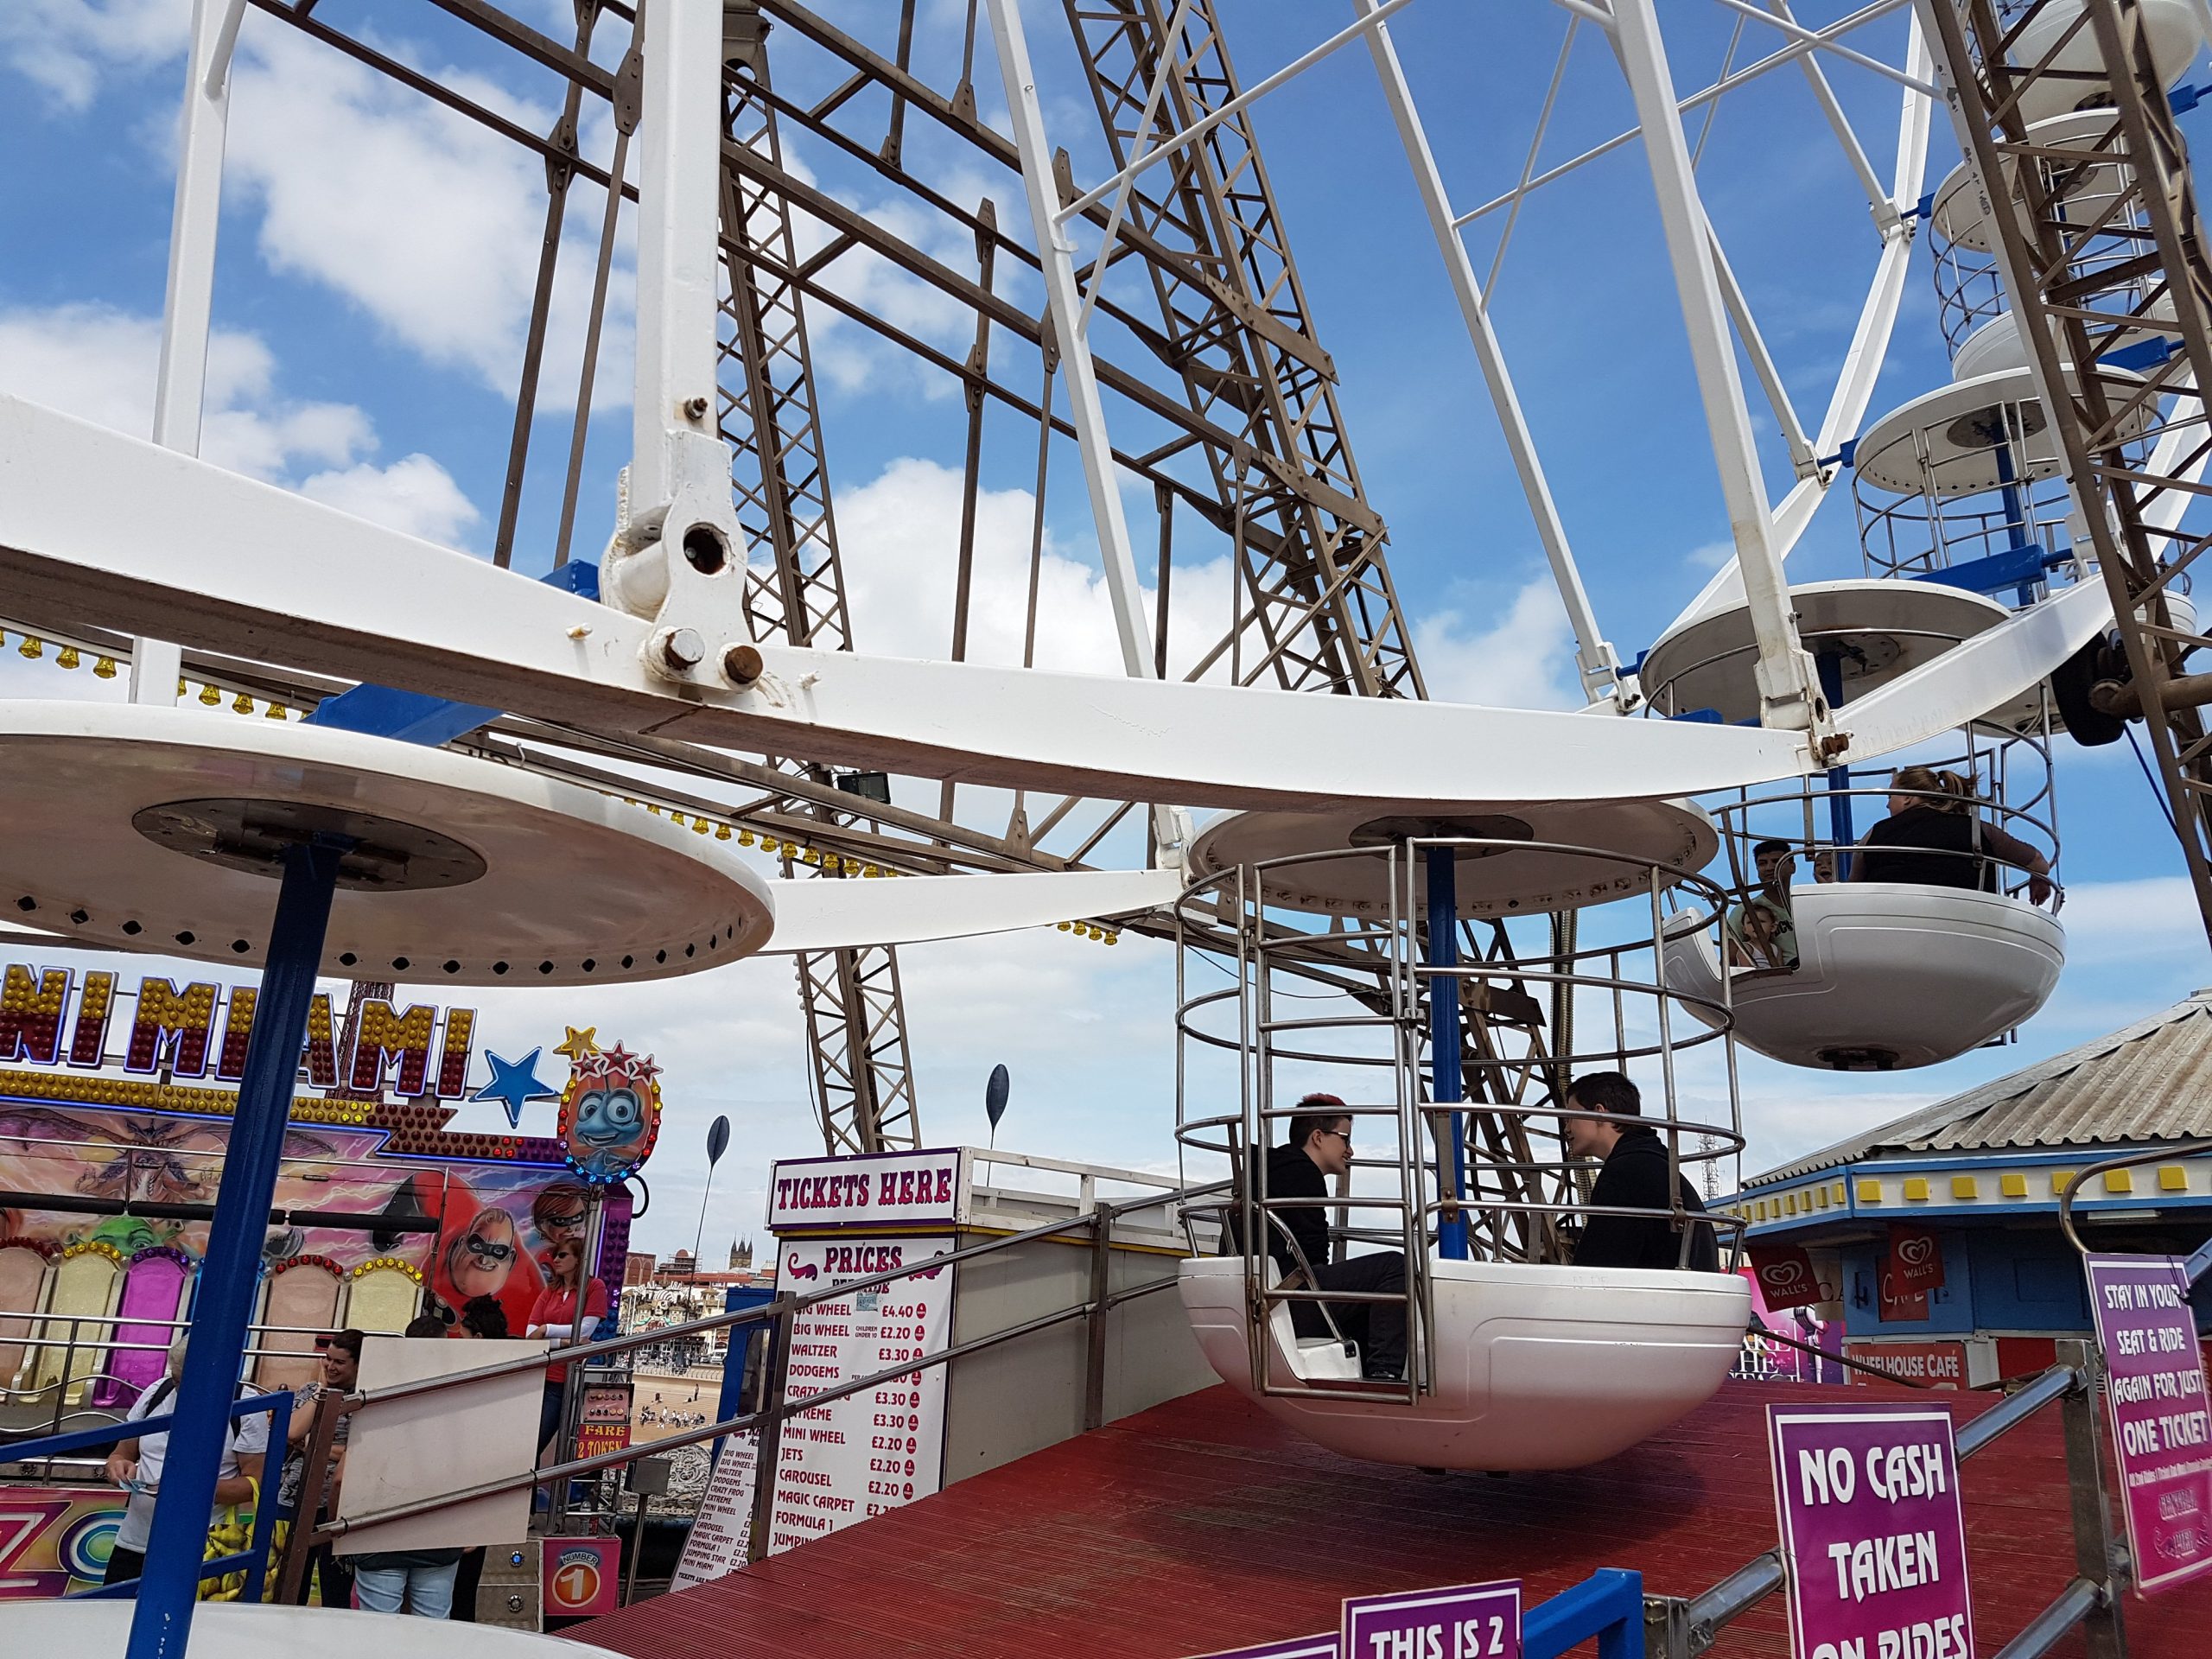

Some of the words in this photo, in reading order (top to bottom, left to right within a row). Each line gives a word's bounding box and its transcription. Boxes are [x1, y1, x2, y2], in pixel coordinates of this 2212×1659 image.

[778, 1174, 870, 1210] TICKETS
[878, 1168, 952, 1206] HERE
[823, 1246, 902, 1274] PRICES
[1904, 1264, 1934, 1280] WALL'S
[1770, 1284, 1808, 1299] WALL'S
[2105, 1285, 2133, 1311] STAY
[2133, 1284, 2149, 1307] IN
[2149, 1284, 2181, 1310] YOUR
[817, 1304, 851, 1317] WHEEL
[882, 1305, 913, 1318] £4.40
[793, 1324, 810, 1336] BIG
[815, 1325, 849, 1337] WHEEL
[880, 1327, 911, 1339] £2.20
[2117, 1330, 2144, 1356] SEAT
[2147, 1330, 2158, 1352] &
[2159, 1327, 2186, 1353] RIDE
[791, 1344, 837, 1358] WALTZER
[879, 1348, 909, 1361] £3.30
[789, 1364, 840, 1378] DODGEMS
[1739, 1351, 1779, 1374] HE
[1927, 1350, 1961, 1377] CAFÉ
[787, 1385, 819, 1398] CRAZY
[875, 1392, 906, 1405] £3.30
[2114, 1375, 2152, 1405] AGAIN
[2153, 1372, 2178, 1399] FOR
[2178, 1370, 2203, 1400] JUST
[791, 1408, 832, 1421] TREME
[874, 1414, 905, 1428] £3.30
[585, 1426, 626, 1436] FARE
[783, 1427, 806, 1440] MINI
[810, 1429, 846, 1445] WHEEL
[872, 1436, 902, 1451] £2.20
[2124, 1418, 2159, 1457] ONE
[2158, 1410, 2209, 1449] TICKET
[577, 1442, 585, 1459] 2
[735, 1451, 754, 1460] WHEEL
[732, 1459, 751, 1469] WHEEL
[781, 1447, 804, 1461] JETS
[870, 1459, 900, 1474] £2.20
[714, 1476, 741, 1486] DODGEMS
[717, 1467, 742, 1478] WALTZER
[1799, 1447, 1855, 1505] NO
[1866, 1444, 1945, 1504] CASH
[710, 1484, 728, 1494] CRAZY
[728, 1488, 744, 1497] FROG
[779, 1469, 832, 1487] CAROUSEL
[868, 1481, 899, 1497] £2.20
[707, 1494, 733, 1504] EXTREME
[778, 1490, 810, 1505] MAGIC
[813, 1495, 855, 1512] CARPET
[867, 1503, 897, 1516] £2.2
[717, 1505, 736, 1516] WHEEL
[696, 1521, 724, 1533] CAROUSEL
[775, 1510, 825, 1530] FORMULA
[829, 1519, 834, 1532] 1
[689, 1540, 716, 1552] FORMULA
[693, 1530, 710, 1540] MAGIC
[711, 1534, 734, 1545] CARPET
[773, 1532, 813, 1548] JUMPI
[560, 1552, 599, 1567] NUMBER
[682, 1558, 696, 1567] MINI
[696, 1560, 715, 1572] MIAMI
[685, 1548, 710, 1560] JUMPING
[711, 1554, 727, 1564] STAR
[730, 1559, 747, 1568] £2.20
[1828, 1531, 1939, 1603] TAKEN
[560, 1569, 584, 1600] 1
[1370, 1624, 1443, 1659] THIS
[1454, 1619, 1479, 1659] IS
[1488, 1616, 1503, 1656] 2
[1878, 1613, 1968, 1659] RIDES
